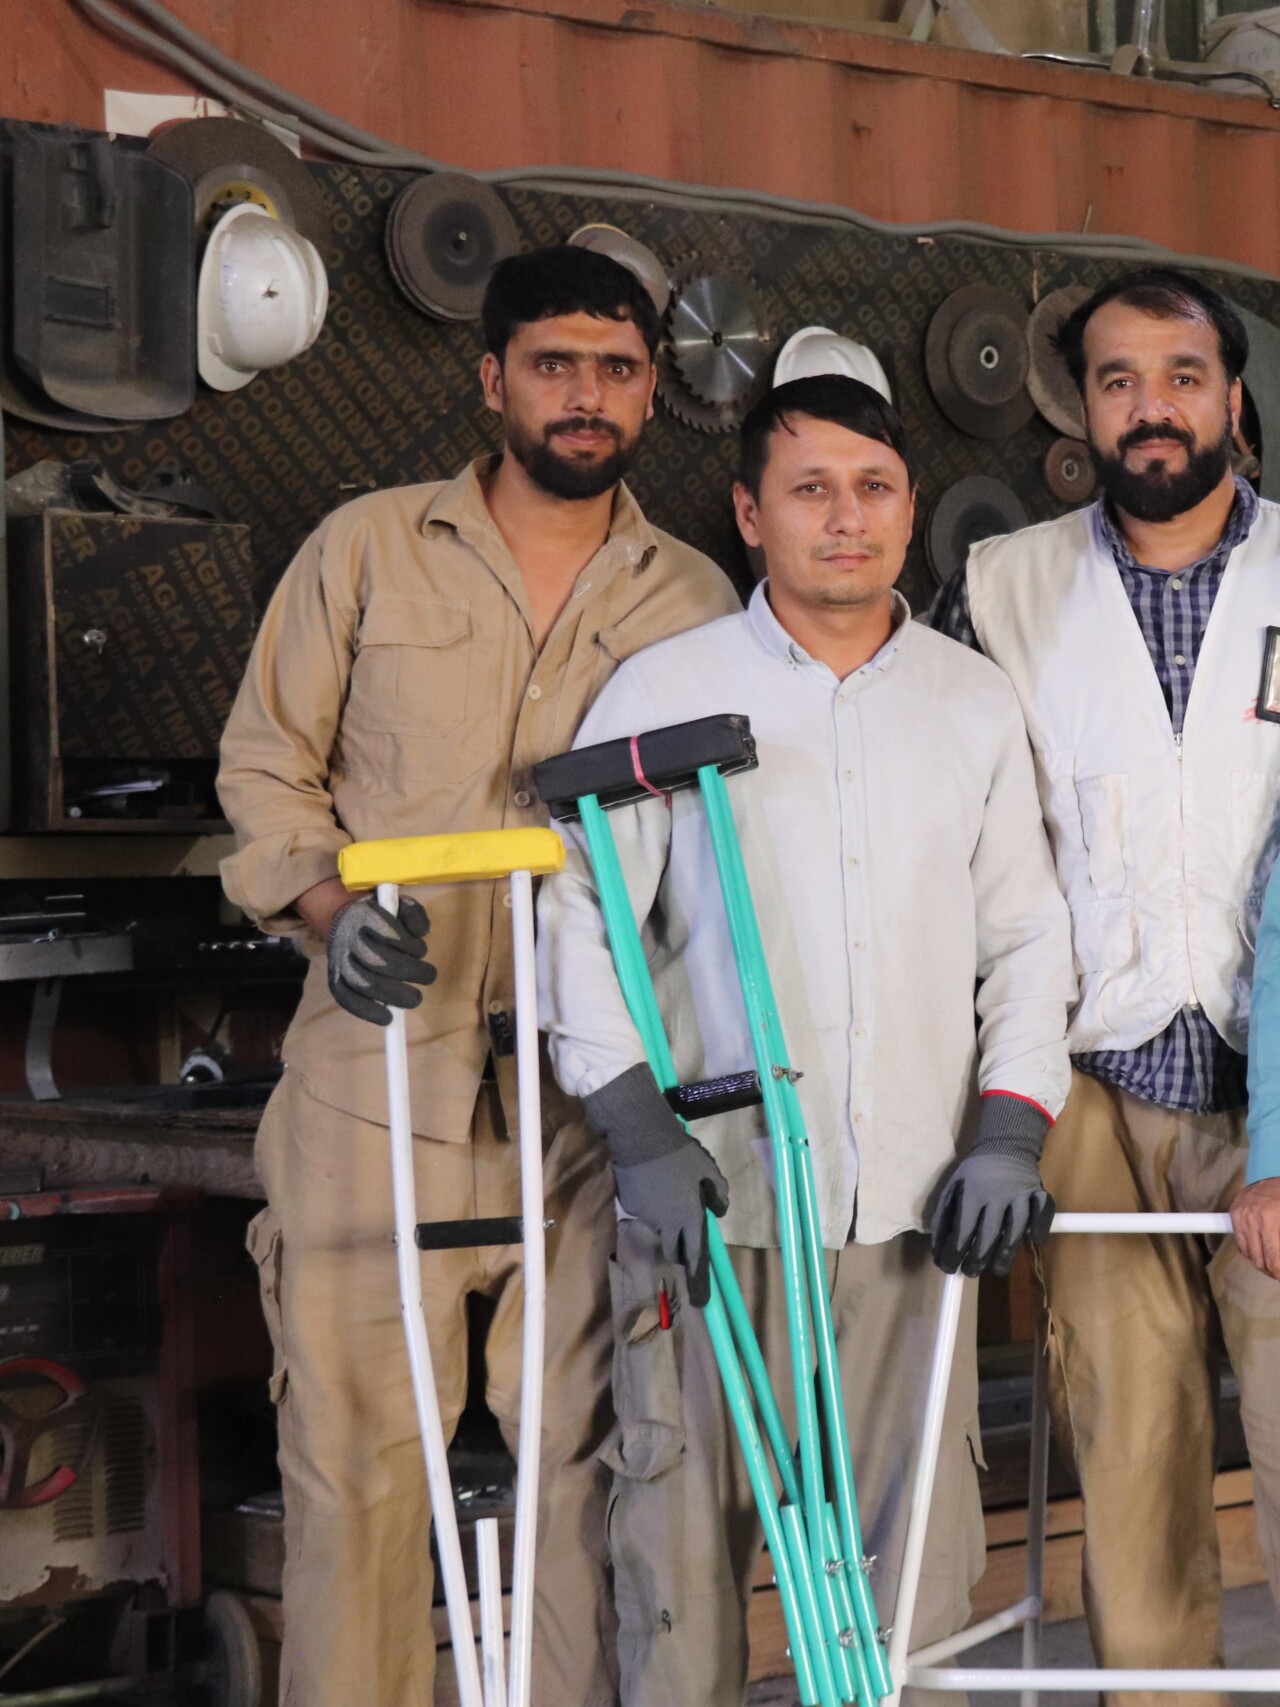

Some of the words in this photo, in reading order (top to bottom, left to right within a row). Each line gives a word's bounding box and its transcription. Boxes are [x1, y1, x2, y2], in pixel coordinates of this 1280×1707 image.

[310, 323, 417, 453] HARDWOO
[317, 286, 438, 434] HARDWOOD
[337, 267, 459, 416] HARDWOOD
[243, 375, 351, 505] HARDWOO
[267, 358, 374, 488] HARDWOO
[164, 414, 289, 567] HARDWOOD
[134, 556, 206, 655] AGHA
[164, 545, 219, 629] PREMIUM
[177, 533, 249, 632] AGHA
[48, 605, 117, 702] AGHA
[91, 579, 162, 679] AGHA
[144, 677, 208, 763] TIMB
[121, 568, 176, 652] PREMIUM
[165, 654, 224, 742] HARDWOO
